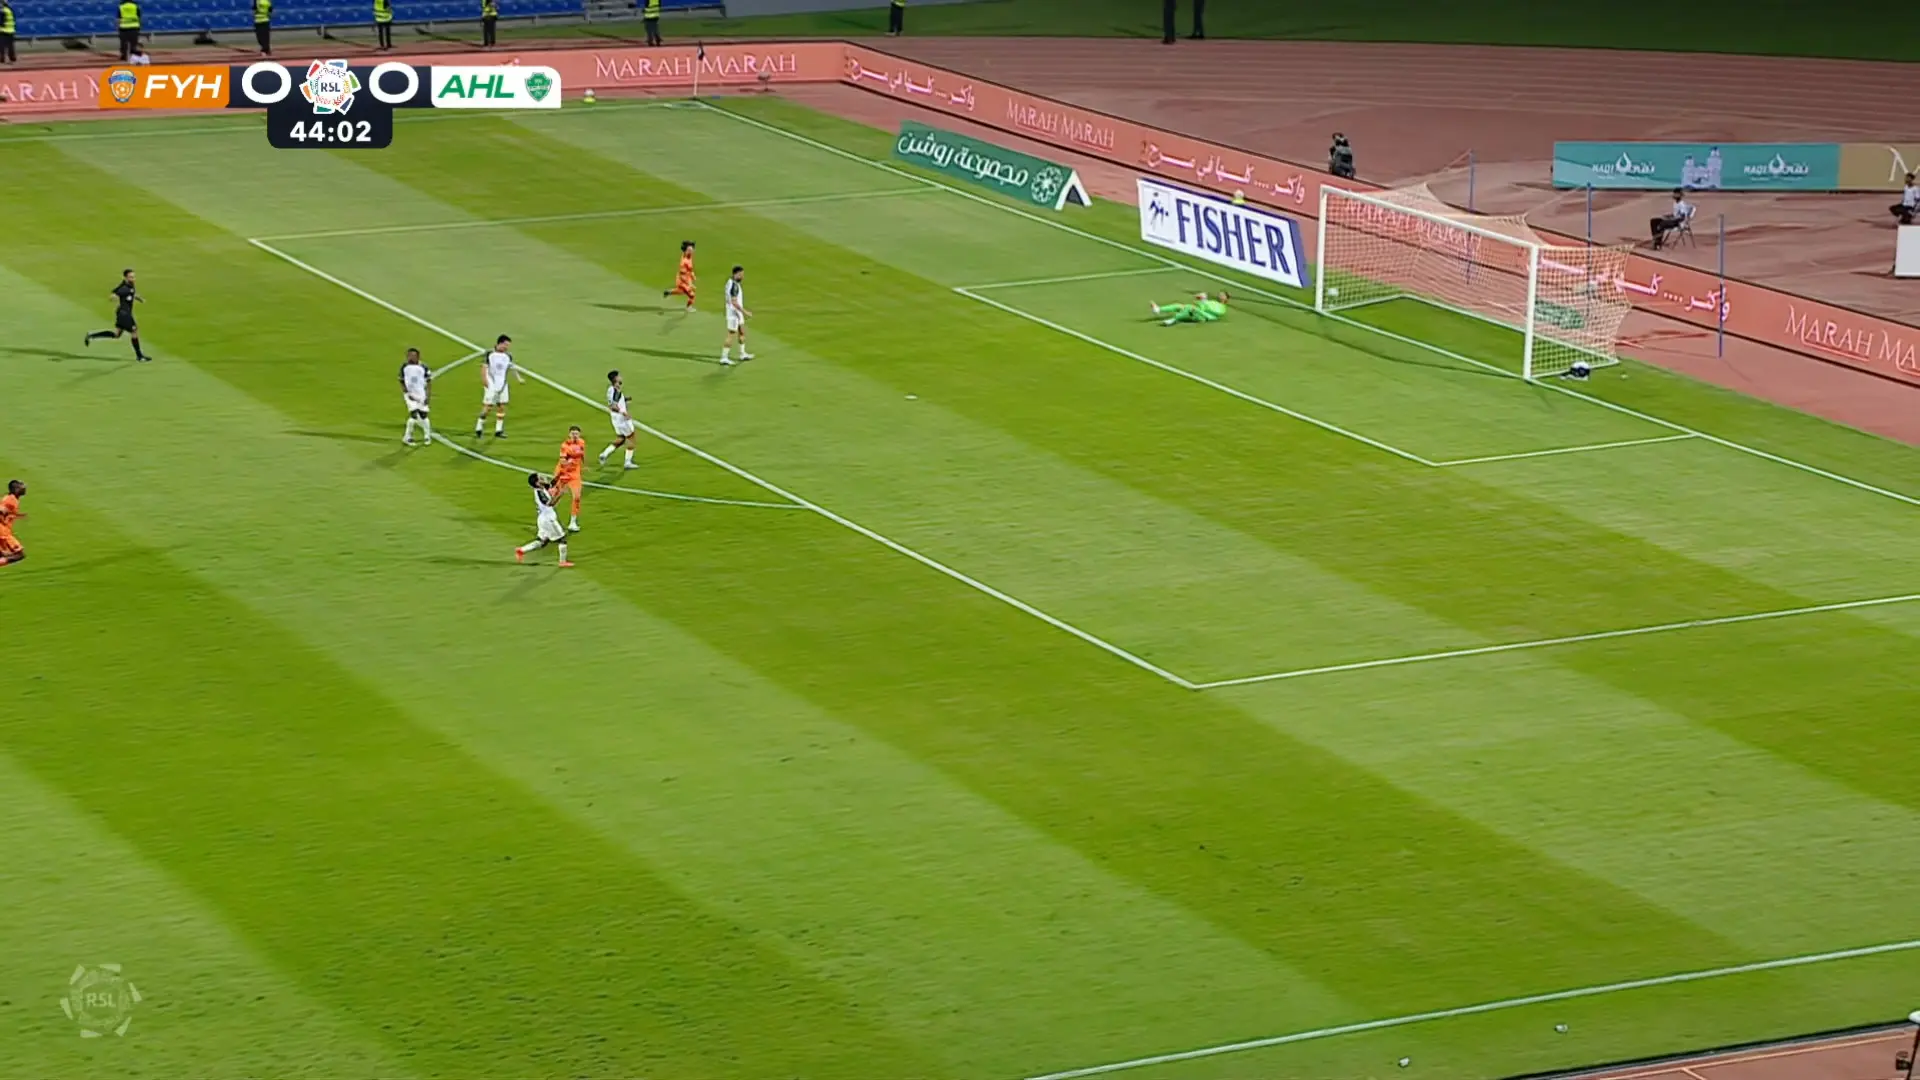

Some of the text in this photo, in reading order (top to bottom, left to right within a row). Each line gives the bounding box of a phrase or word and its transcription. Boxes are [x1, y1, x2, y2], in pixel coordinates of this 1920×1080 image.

[595, 53, 796, 79] MARAH MARAH
[1006, 98, 1115, 151] MARAH MARAH
[897, 131, 1029, 187] مجموعة روشن
[1175, 198, 1291, 275] FISHER
[1785, 304, 1875, 360] MARAH
